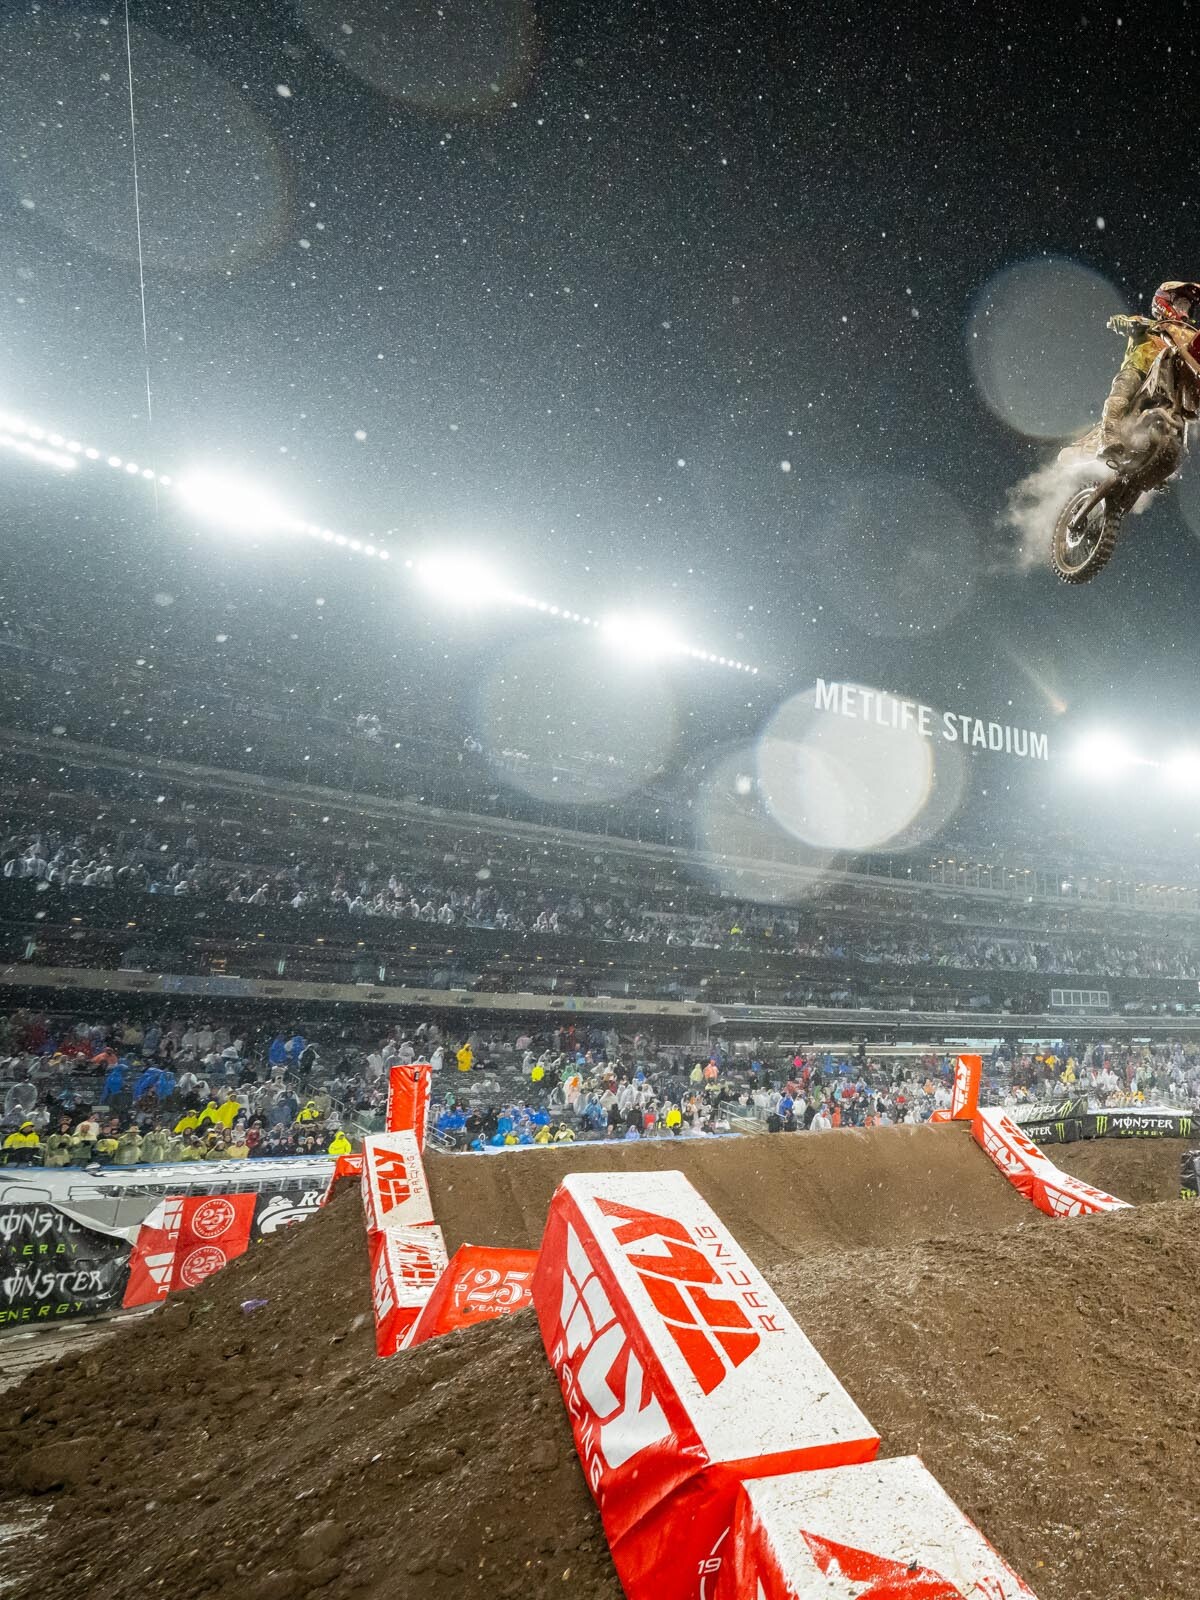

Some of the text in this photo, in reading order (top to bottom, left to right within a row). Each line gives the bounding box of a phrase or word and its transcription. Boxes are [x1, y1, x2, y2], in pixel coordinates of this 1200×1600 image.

[814, 678, 1049, 760] METLIFE STADIUM
[1023, 1125, 1052, 1138] NSTER
[1113, 1115, 1174, 1130] MONSTER
[201, 1207, 227, 1226] 25
[191, 1255, 219, 1273] 25
[3, 1266, 104, 1304] ONSTER
[467, 1268, 530, 1305] 25
[694, 1224, 785, 1333] RACING
[470, 1304, 511, 1314] YEARS
[594, 1196, 762, 1397] FLY
[551, 1344, 605, 1494] RACING
[697, 1557, 723, 1575] 19
